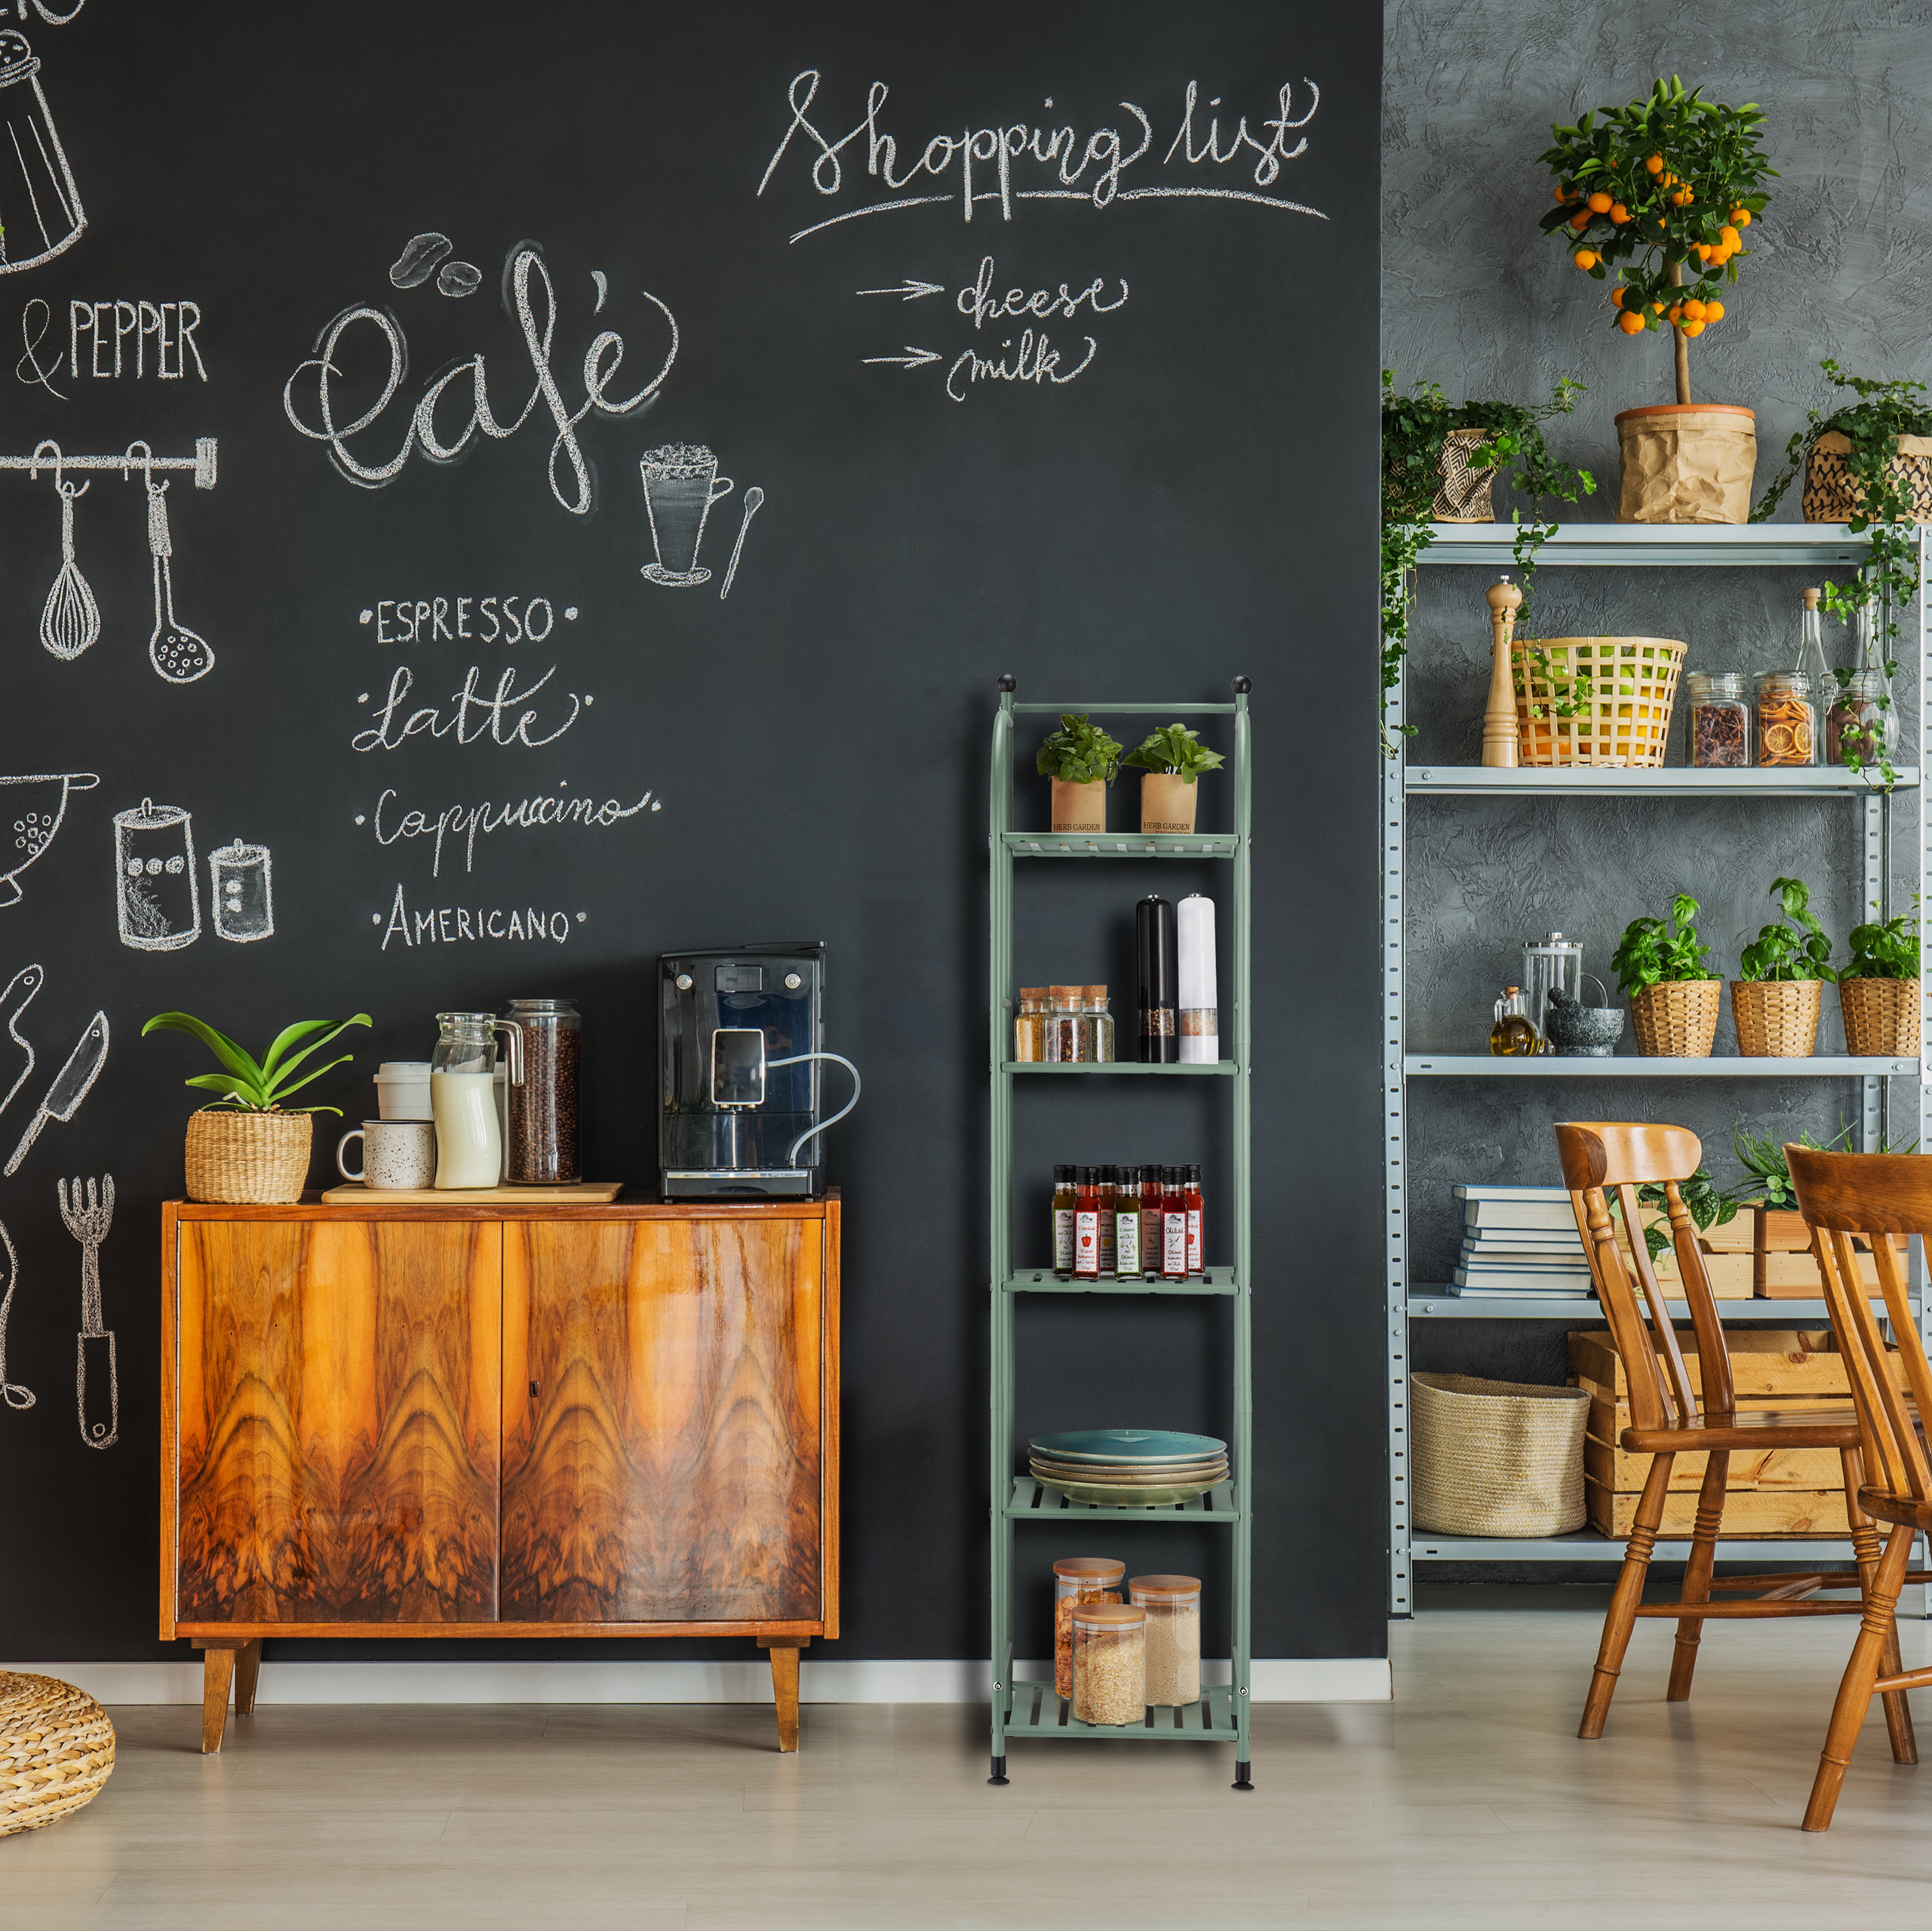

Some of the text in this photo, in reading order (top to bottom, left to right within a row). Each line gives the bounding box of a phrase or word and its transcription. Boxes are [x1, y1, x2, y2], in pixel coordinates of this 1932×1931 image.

[757, 69, 1320, 223] Shopping list
[957, 256, 1129, 329] cheese
[70, 299, 207, 382] PEPPER
[947, 329, 1097, 402] milk
[284, 249, 680, 514] Café
[377, 597, 554, 644] ESPRESSO
[352, 665, 579, 752] Latte
[1144, 821, 1190, 830] HERB GARDEN
